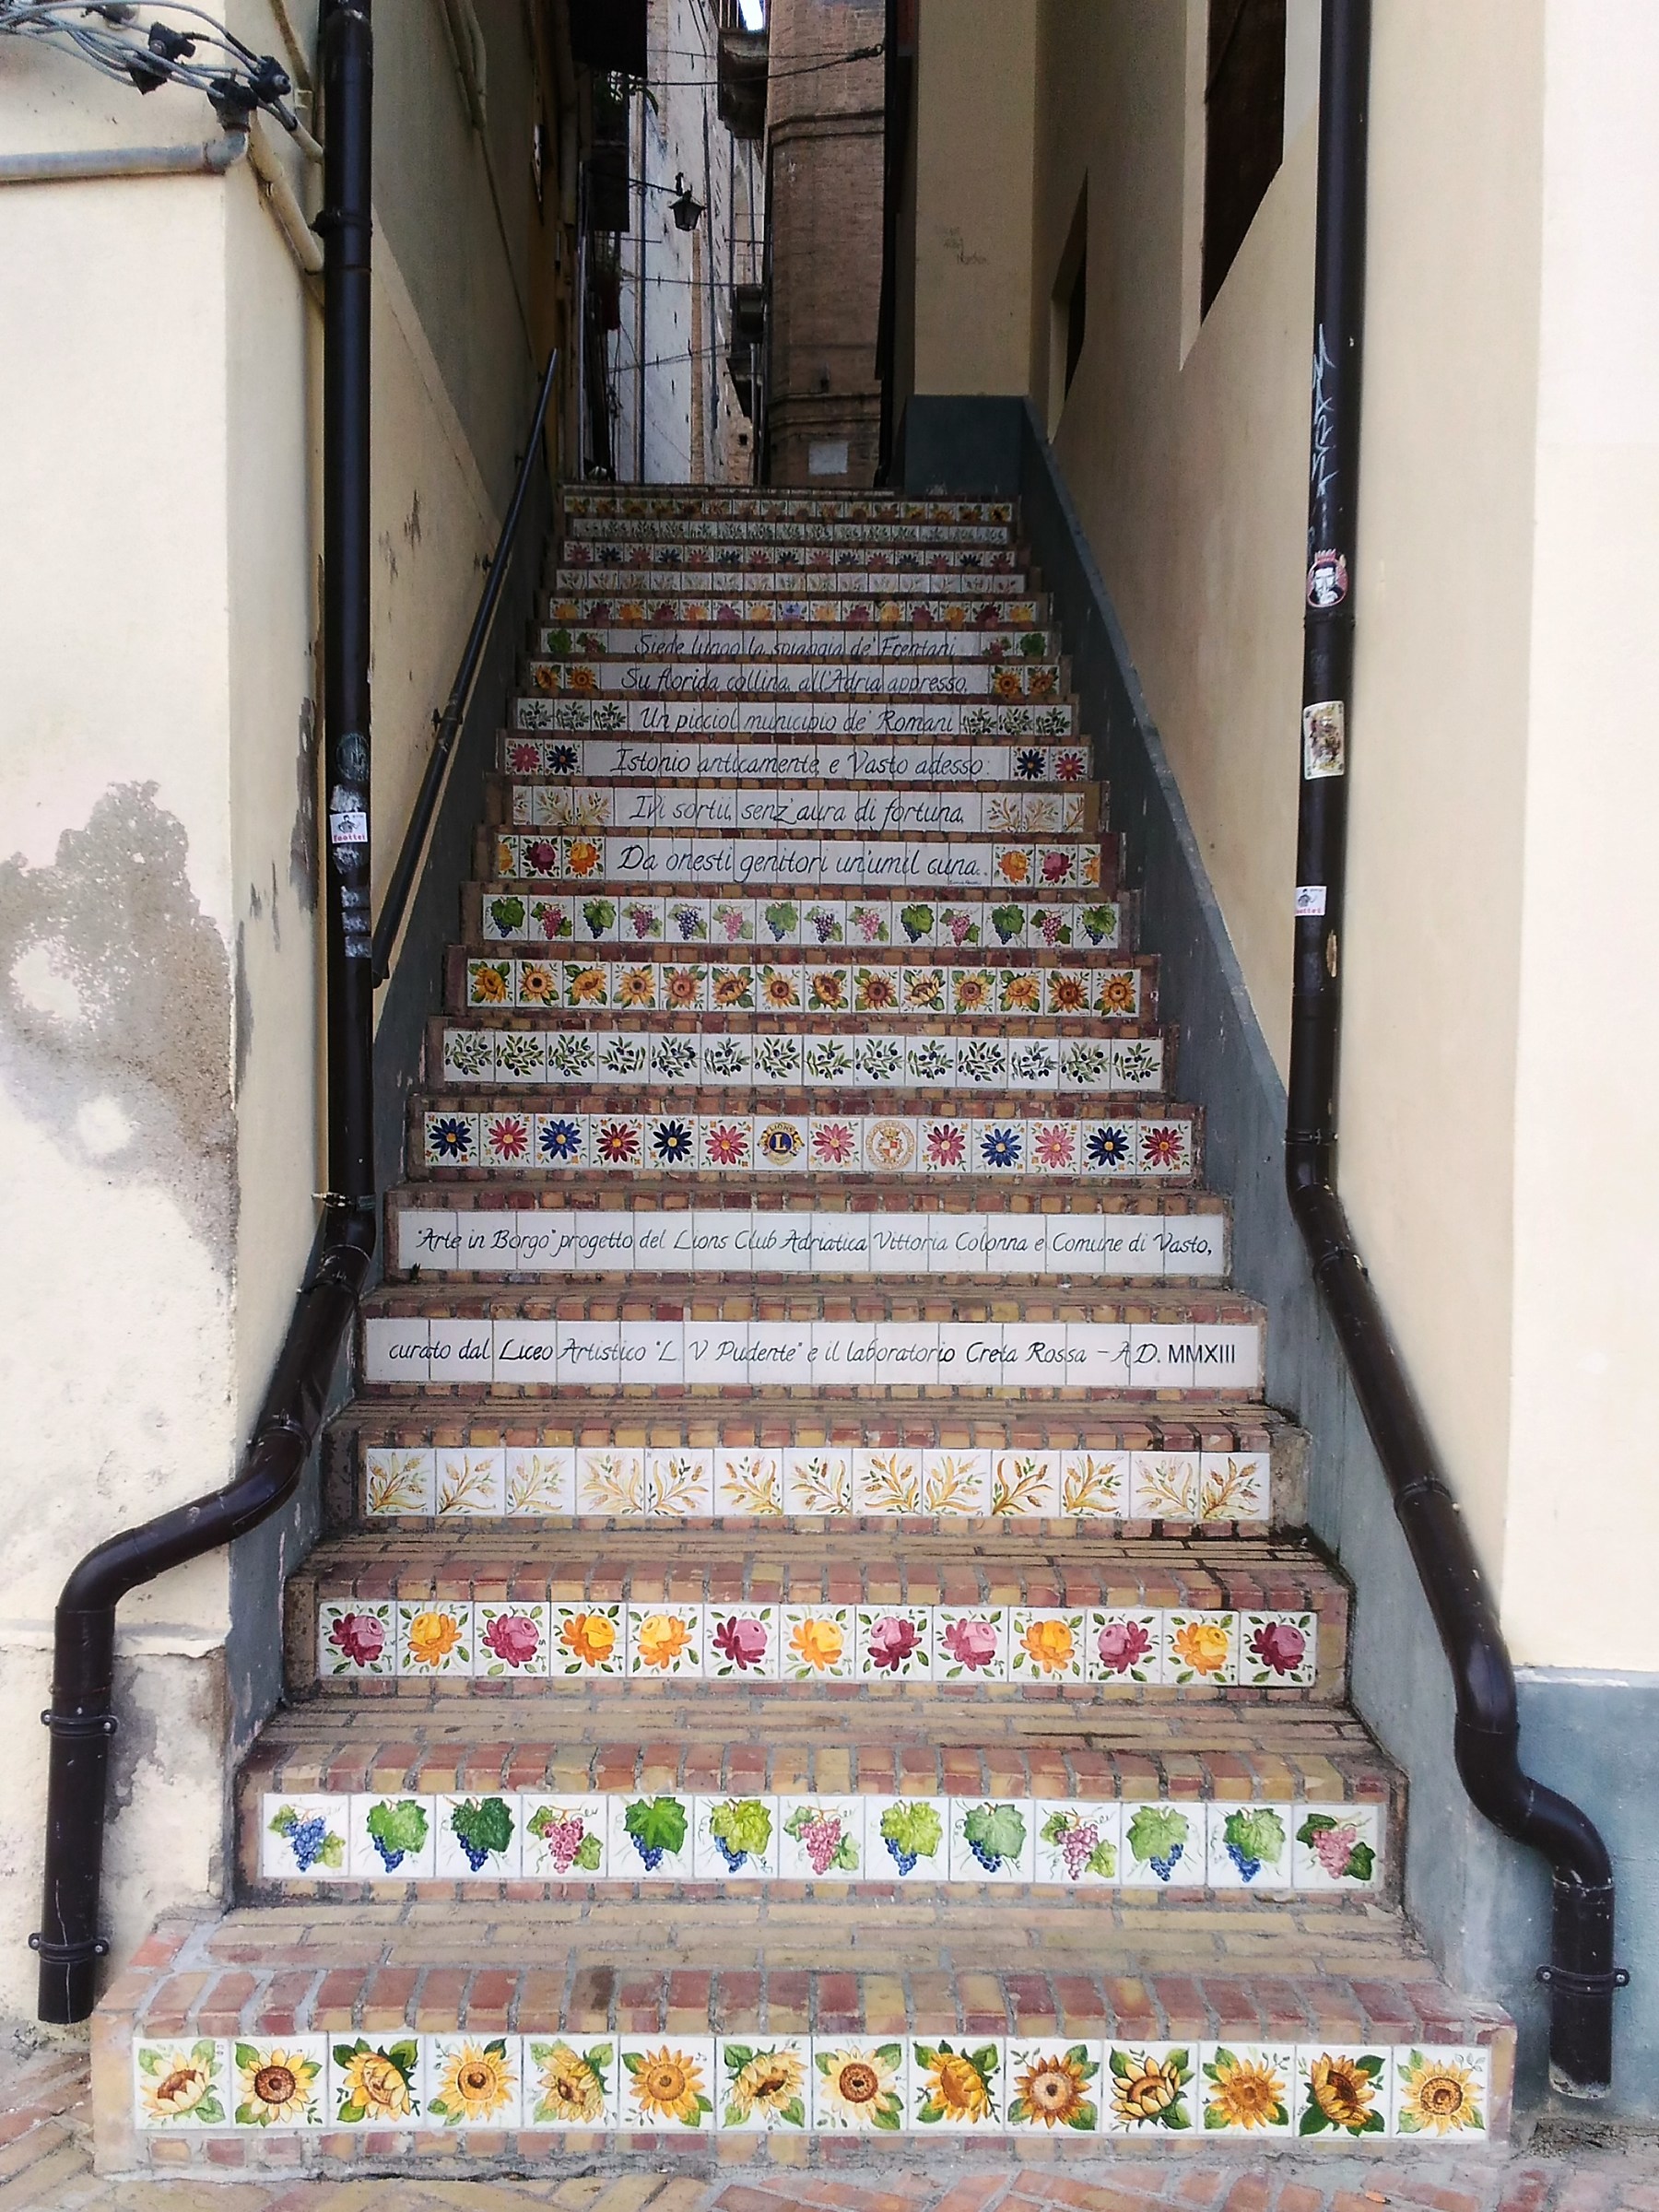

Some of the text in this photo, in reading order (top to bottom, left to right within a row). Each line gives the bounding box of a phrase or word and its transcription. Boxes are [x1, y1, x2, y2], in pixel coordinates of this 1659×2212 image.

[748, 636, 766, 655] la
[881, 634, 957, 655] Frentani
[621, 667, 651, 689] Su
[657, 666, 720, 691] florida
[798, 668, 882, 691] all'Adria
[641, 707, 670, 729] Un
[676, 706, 739, 732] picciol
[744, 709, 837, 732] municipio
[876, 710, 955, 732] Romani
[610, 747, 691, 772] Istonio
[830, 759, 841, 774] e
[847, 750, 909, 775] Vasto
[629, 794, 665, 820] Ivi
[854, 798, 877, 822] di
[617, 844, 658, 870] Da
[665, 846, 734, 873] onesti
[734, 847, 828, 884] genitori
[836, 848, 921, 876] un'umil
[774, 1134, 787, 1151] L
[468, 1229, 486, 1249] in
[549, 1230, 633, 1259] progetto
[640, 1229, 667, 1250] del
[673, 1230, 731, 1251] Lions
[735, 1229, 778, 1251] Club
[779, 1229, 869, 1253] Adriatica
[873, 1230, 948, 1252] Vittoria
[955, 1230, 1028, 1253] Colonna
[1034, 1238, 1046, 1253] e
[1053, 1232, 1124, 1253] Comune
[1128, 1231, 1148, 1253] di
[1153, 1231, 1212, 1256] Vasto,
[388, 1340, 452, 1360] curato
[457, 1337, 491, 1360] dal
[498, 1338, 554, 1361] Liceo
[557, 1337, 647, 1364] Artistico
[807, 1345, 819, 1363] e
[824, 1339, 841, 1362] il
[846, 1337, 956, 1363] laboratorio
[967, 1340, 1018, 1363] Creta
[1024, 1340, 1087, 1364] Rossa
[1168, 1344, 1236, 1364] MMXIII
